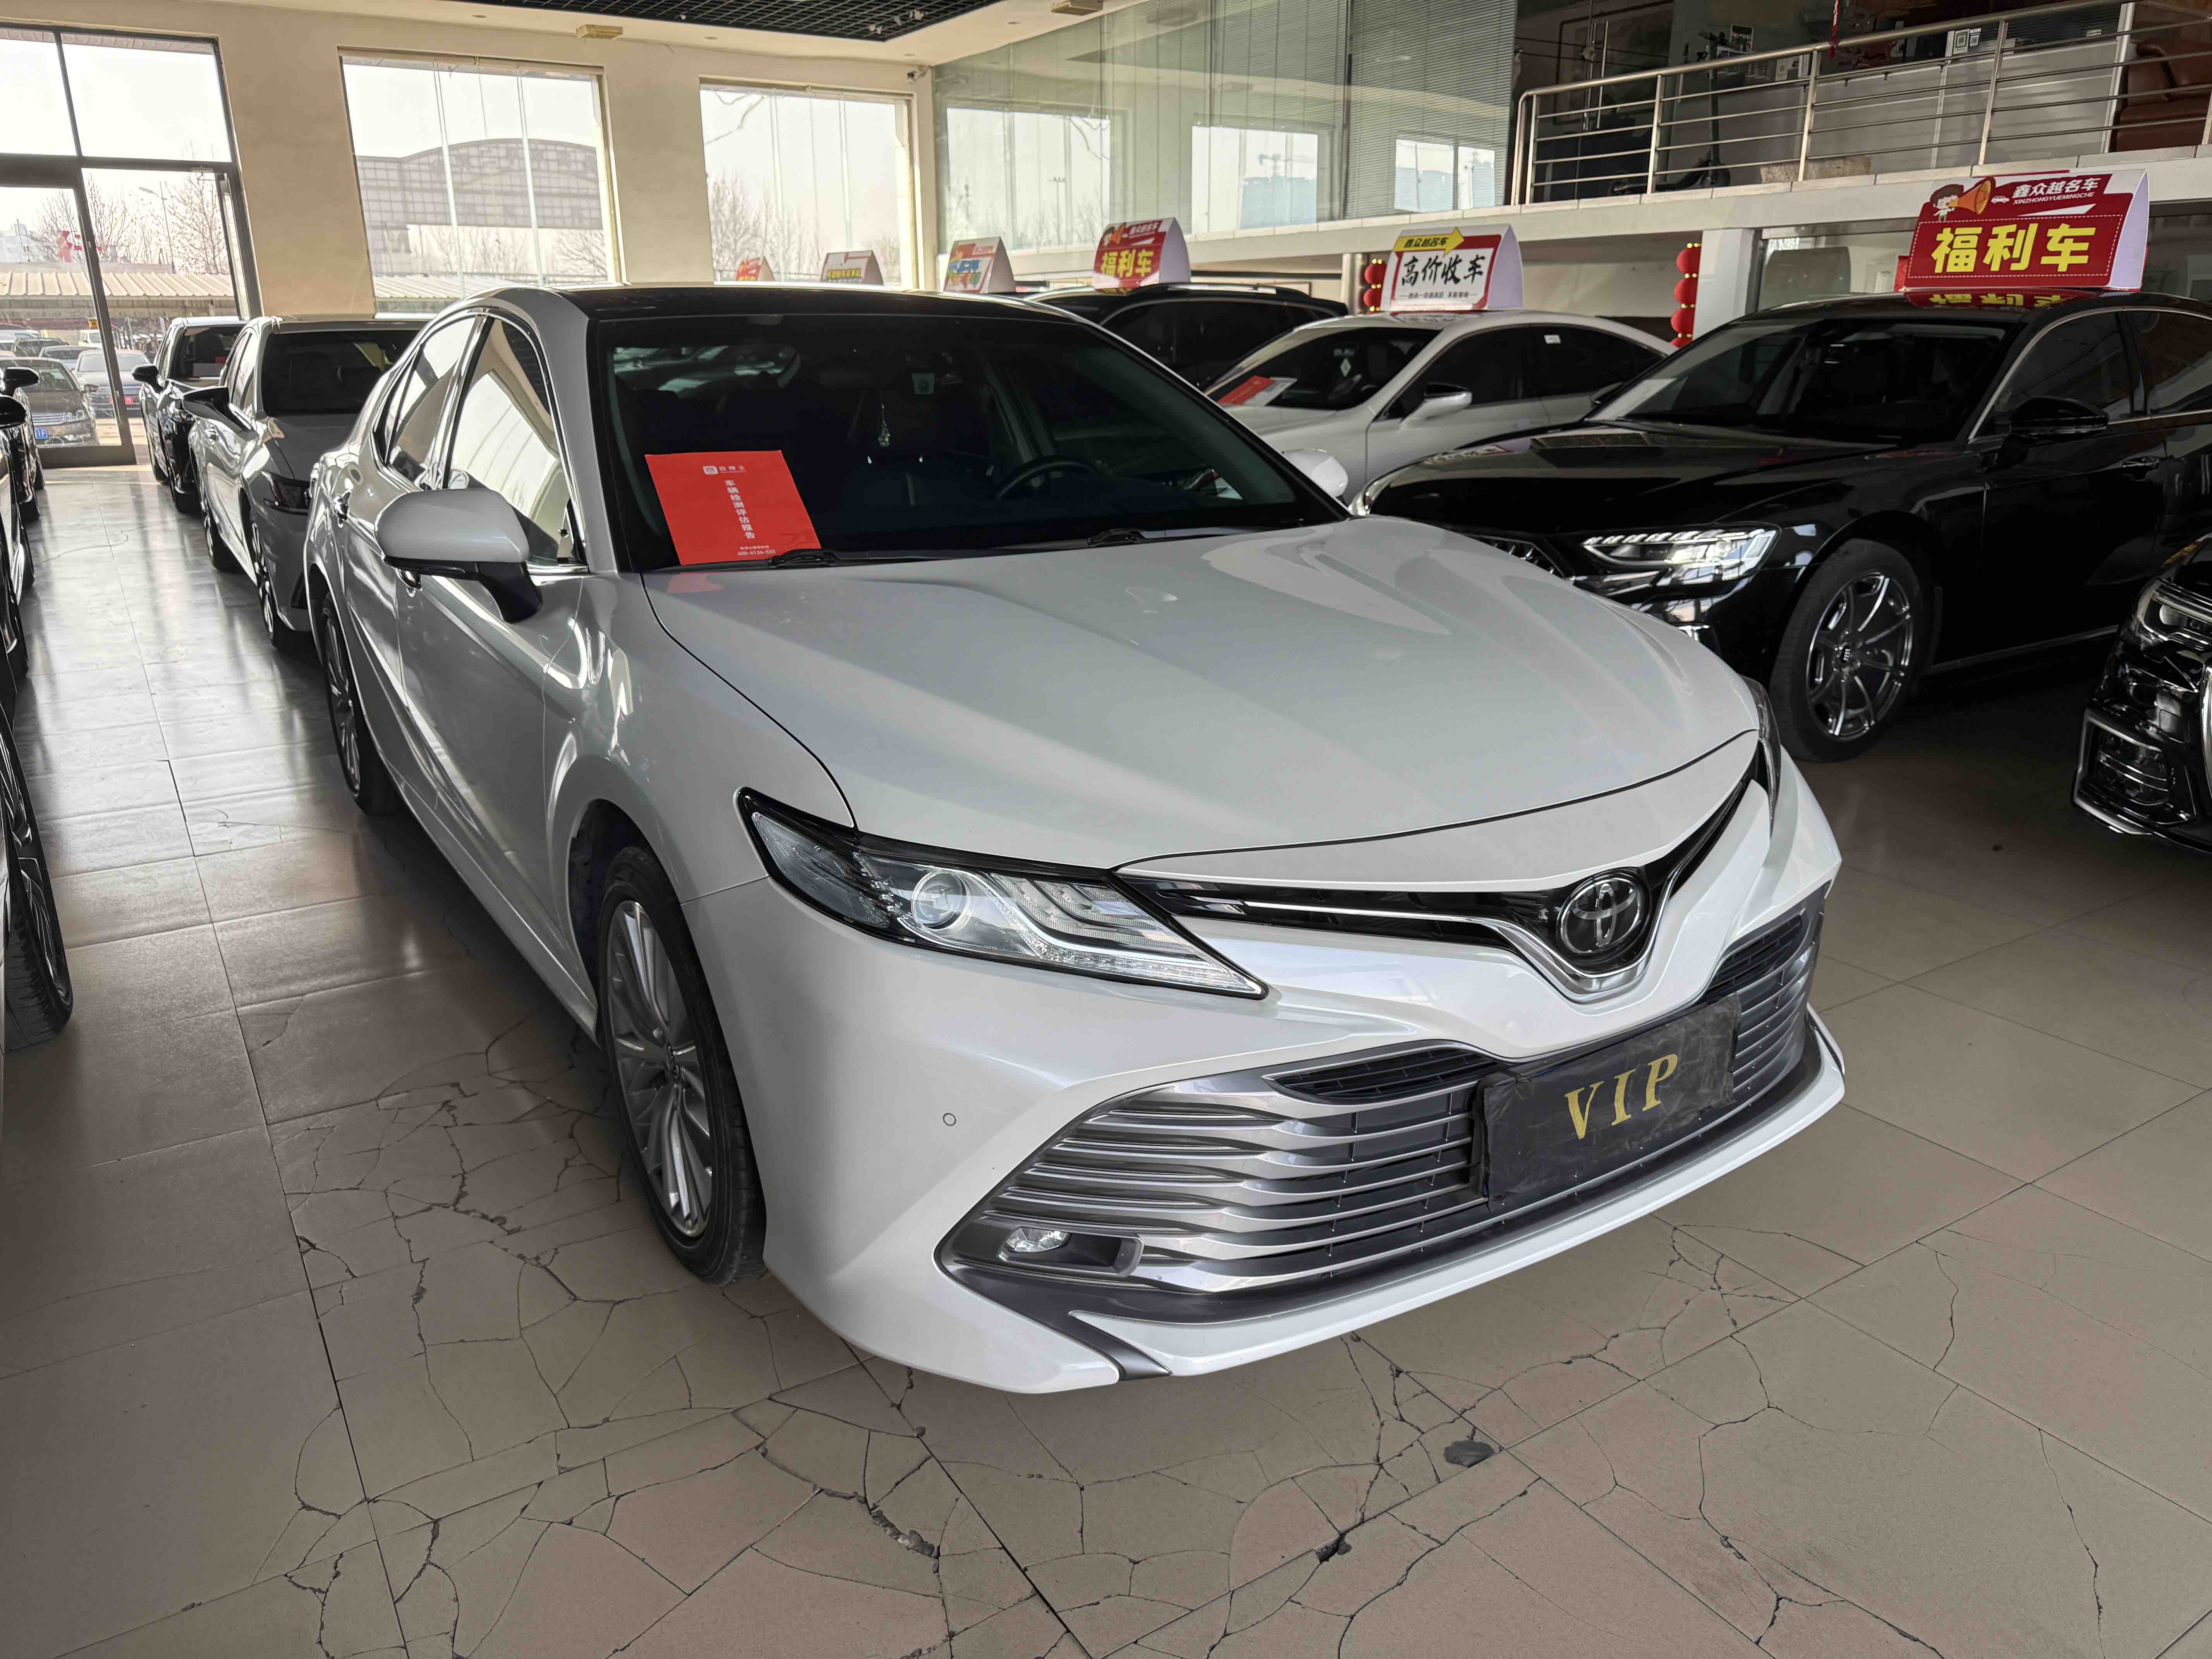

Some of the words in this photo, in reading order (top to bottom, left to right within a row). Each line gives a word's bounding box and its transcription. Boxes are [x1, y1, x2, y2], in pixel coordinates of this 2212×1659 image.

[2012, 177, 2101, 198] 鑫众越名车
[2013, 191, 2094, 204] XINZHONGYUEMINGCHE
[1101, 249, 1155, 278] 福利车
[1931, 223, 2096, 273] 福利车
[1401, 254, 1486, 286] 高价收车
[724, 479, 755, 539] 车辆检测评估报告
[1565, 1053, 1678, 1140] VIP
